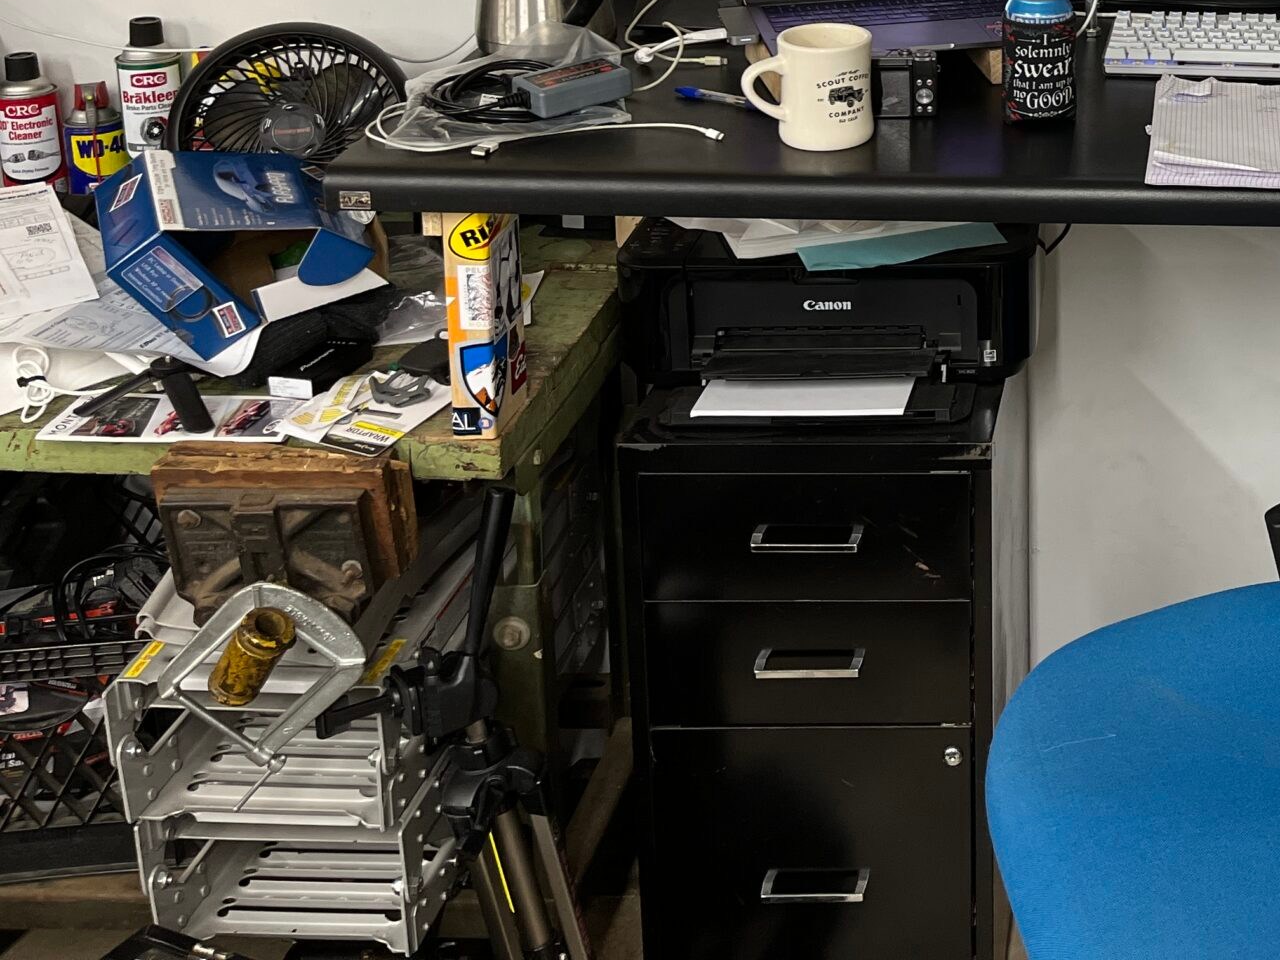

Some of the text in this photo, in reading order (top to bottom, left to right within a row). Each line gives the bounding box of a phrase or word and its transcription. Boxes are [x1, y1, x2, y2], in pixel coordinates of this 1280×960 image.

[1043, 34, 1048, 45] I
[131, 73, 167, 87] CRC
[816, 78, 845, 89] SCOUT
[1013, 79, 1029, 90] that
[1038, 82, 1053, 90] am
[1055, 81, 1066, 90] up
[1013, 89, 1026, 99] no
[5, 104, 41, 118] CRC
[829, 105, 865, 118] COMPANY
[11, 118, 53, 131] Electronic
[8, 131, 43, 141] Cleaner
[803, 300, 852, 311] Canon
[345, 426, 390, 444] WRAPTOR
